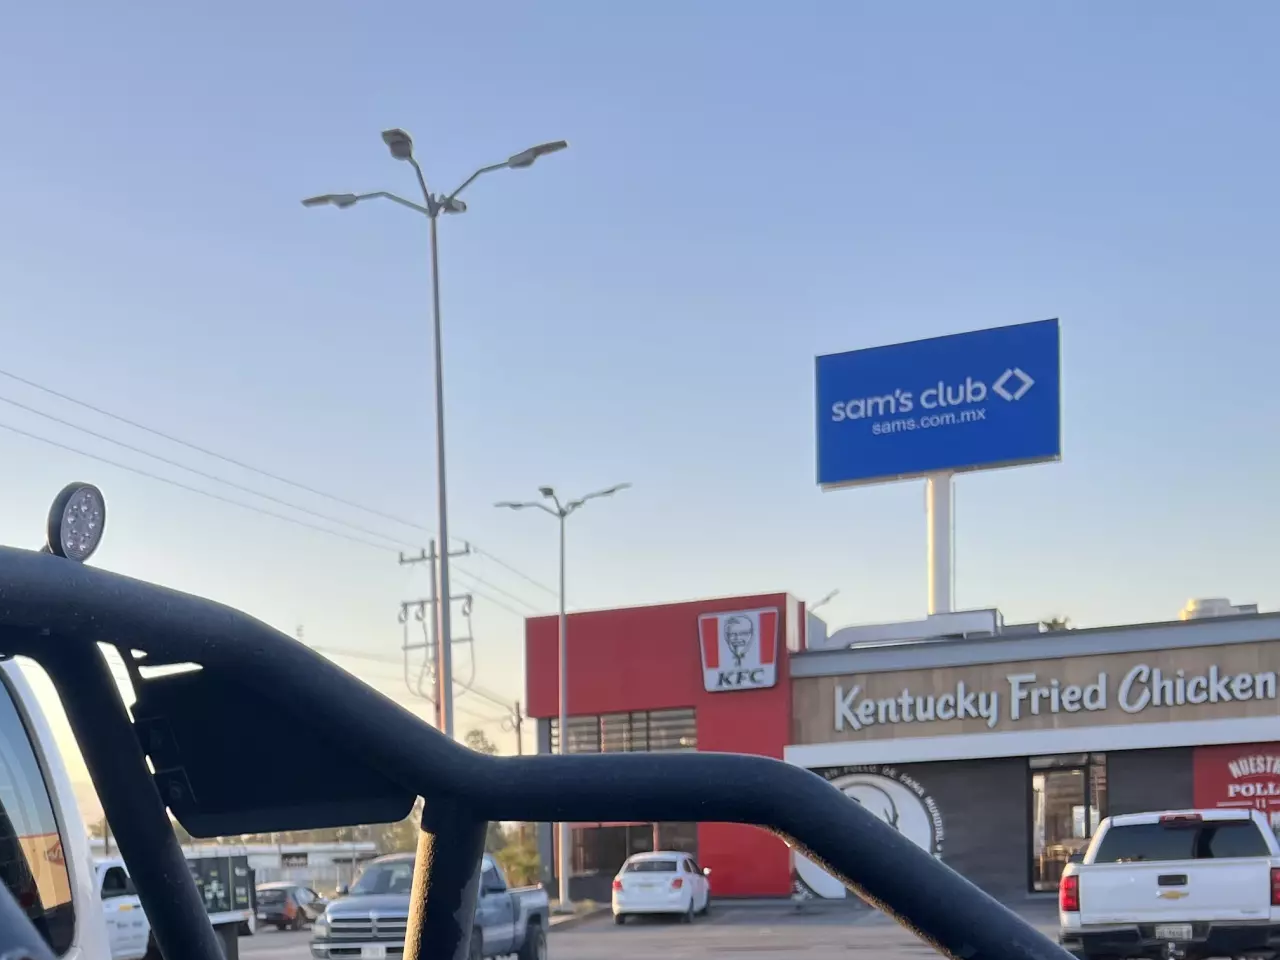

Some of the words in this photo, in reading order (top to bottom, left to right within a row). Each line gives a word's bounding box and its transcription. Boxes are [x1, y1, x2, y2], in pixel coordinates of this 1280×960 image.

[831, 388, 913, 422] sam's
[919, 376, 988, 410] club
[872, 408, 986, 435] sams.com.mx
[716, 668, 765, 687] KFC
[833, 681, 998, 732] Kentucky
[1007, 672, 1107, 720] Fried
[1118, 663, 1277, 714] Chicken
